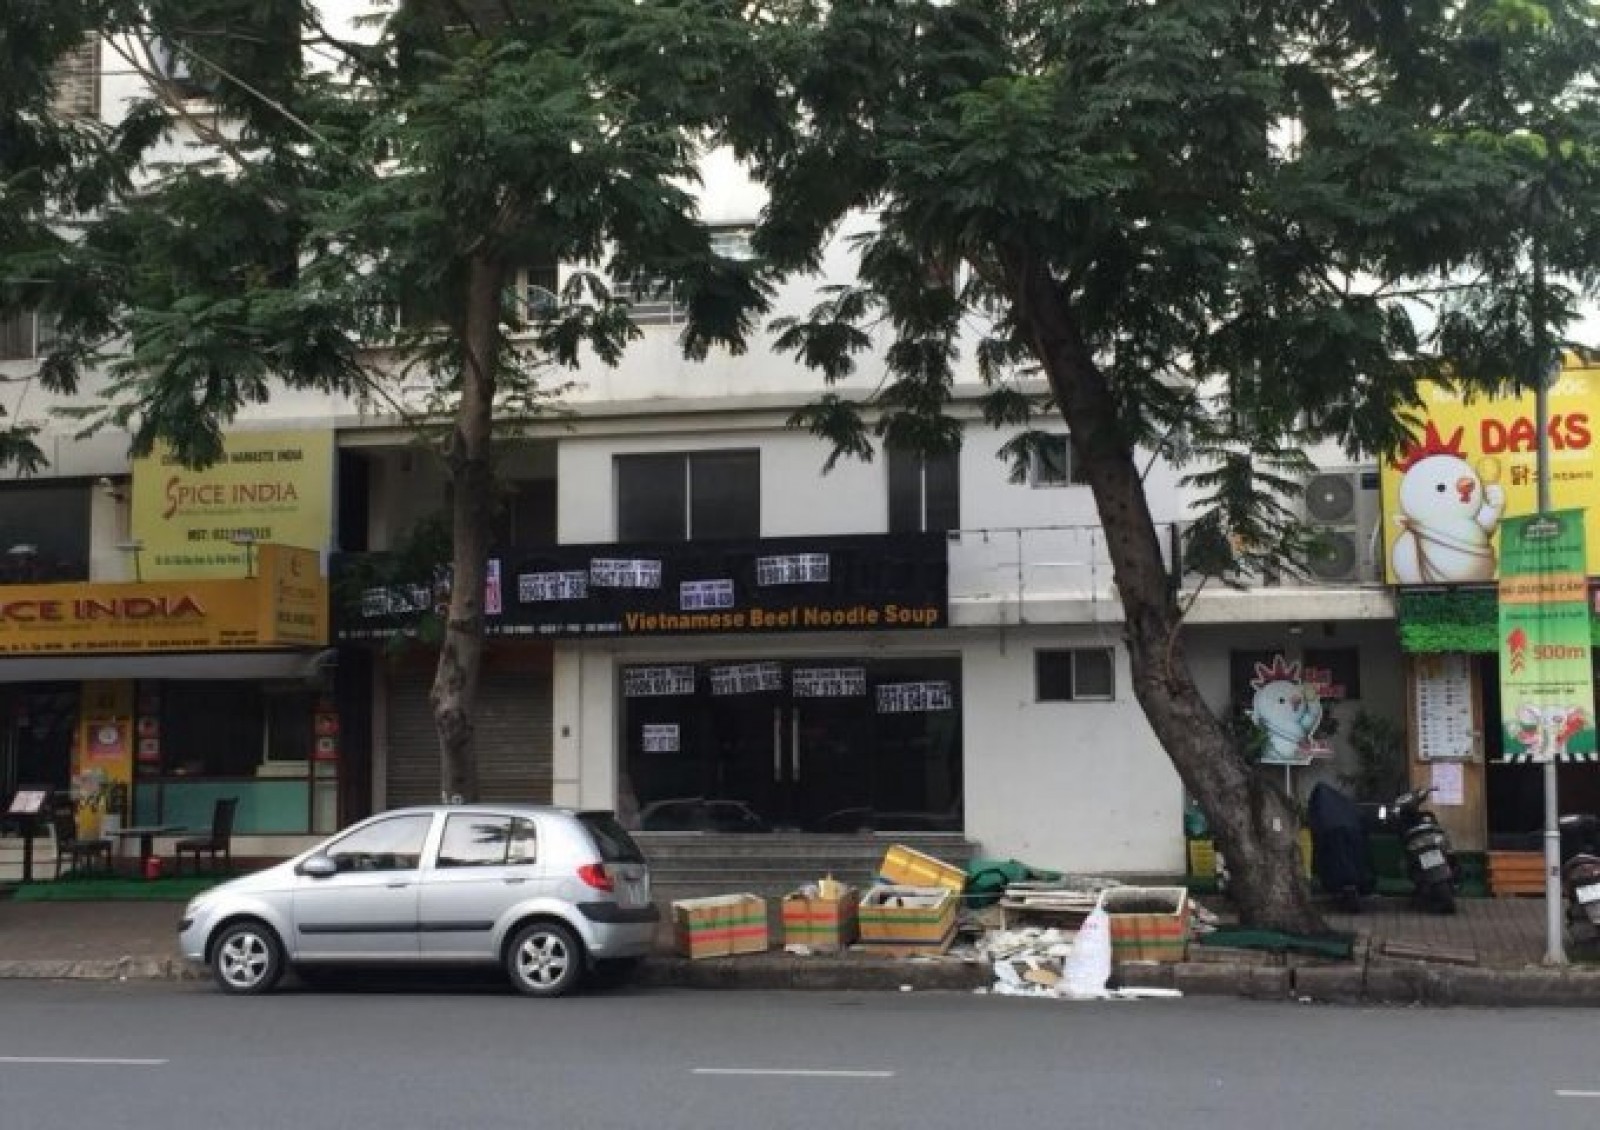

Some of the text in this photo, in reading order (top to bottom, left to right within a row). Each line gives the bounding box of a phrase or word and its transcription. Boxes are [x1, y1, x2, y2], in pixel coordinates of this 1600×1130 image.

[163, 476, 299, 520] SPICE INDIA
[74, 597, 207, 620] INDIA
[625, 611, 745, 631] Vietnamese
[750, 607, 798, 627] Beef
[804, 606, 879, 625] Noodle
[884, 604, 938, 625] Soup
